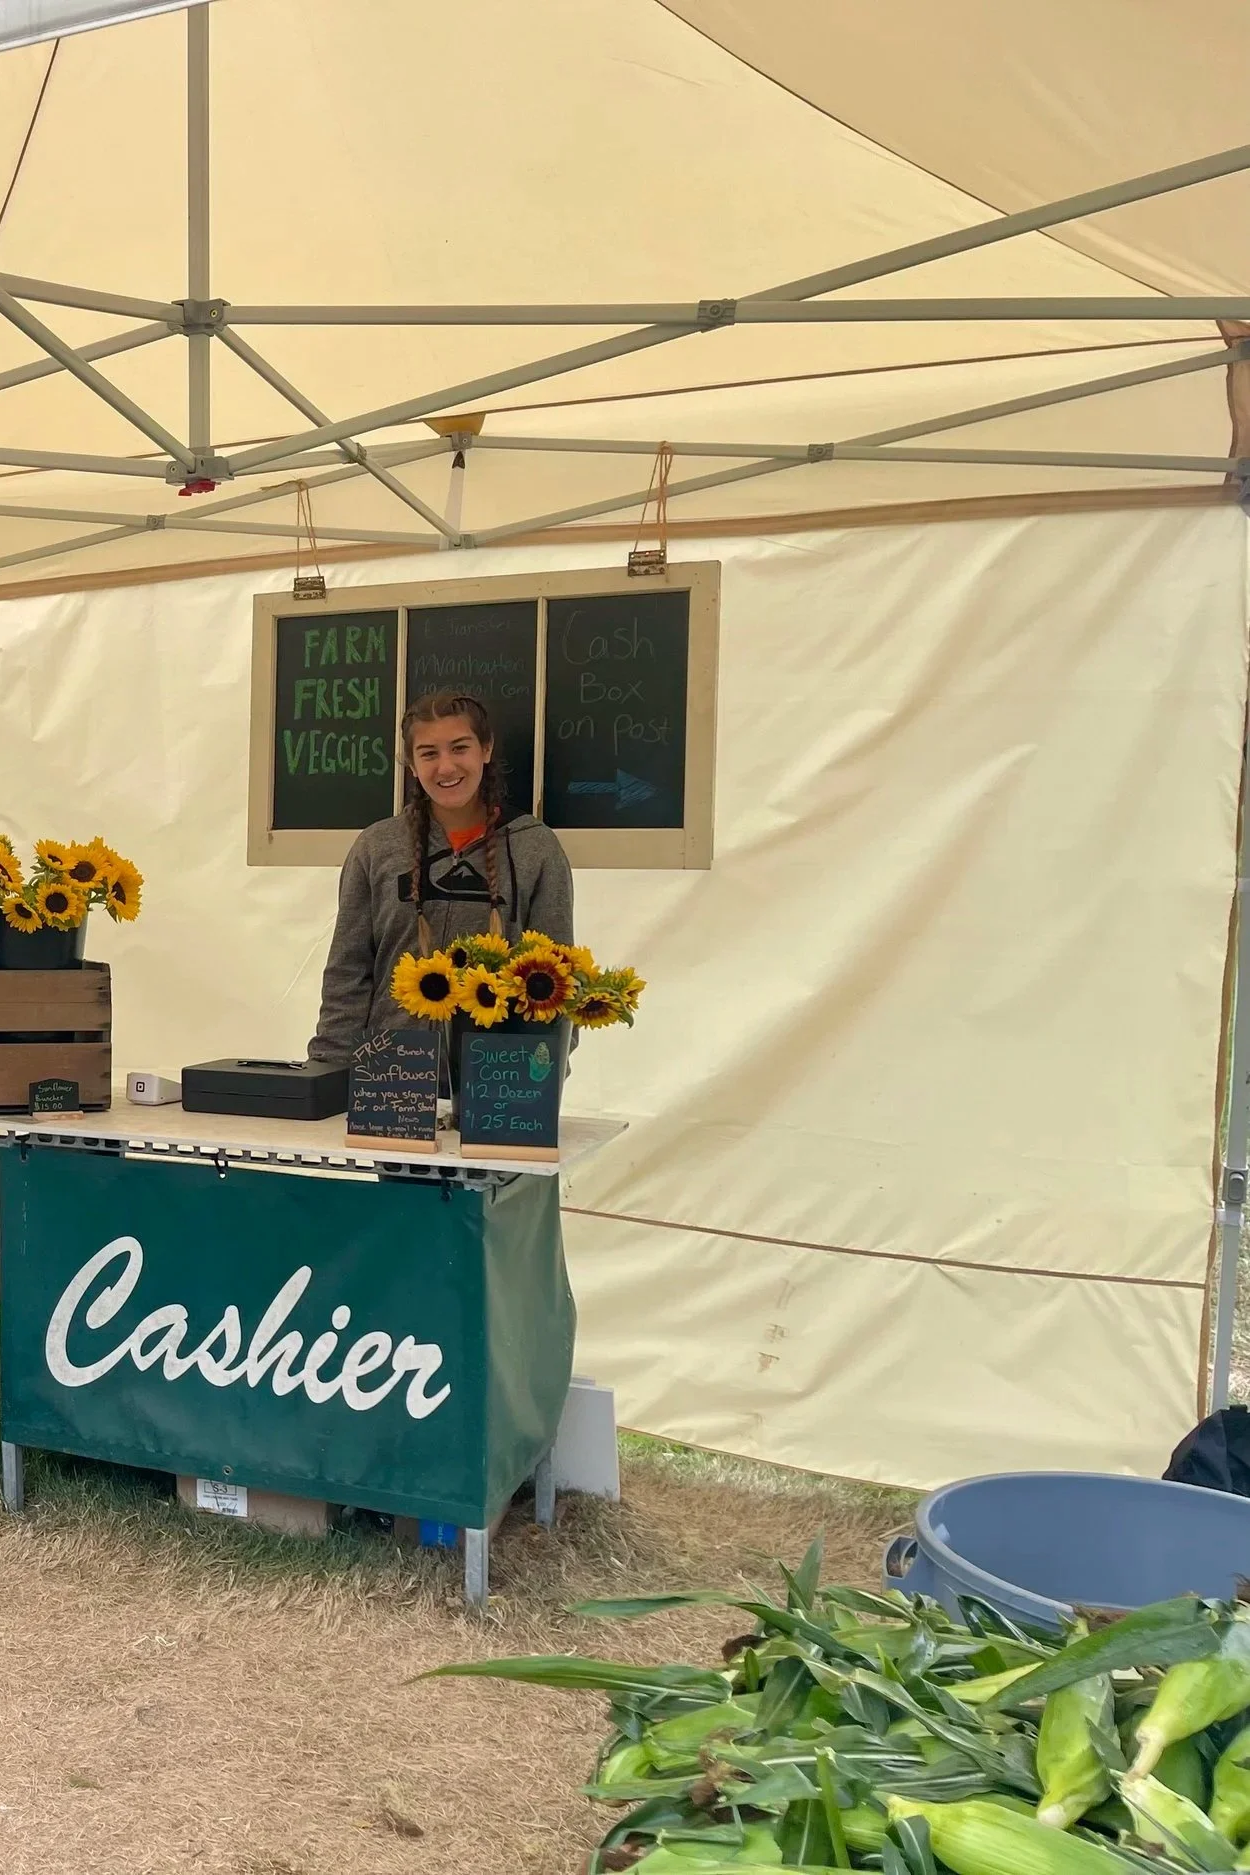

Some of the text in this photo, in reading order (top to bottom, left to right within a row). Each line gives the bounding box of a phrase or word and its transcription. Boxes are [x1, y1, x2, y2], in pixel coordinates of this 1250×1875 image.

[304, 625, 386, 668] FARM
[562, 610, 655, 665] Cash
[294, 677, 379, 720] FRESH
[580, 672, 645, 704] Box
[558, 715, 594, 739] on
[352, 1029, 393, 1063] FREE
[396, 1045, 425, 1057] Bunch
[469, 1038, 529, 1065] Sweet
[354, 1064, 437, 1082] Sunflowers
[479, 1064, 520, 1082] Corn
[380, 1091, 398, 1104] you
[402, 1090, 422, 1104] sign
[424, 1093, 435, 1104] up
[499, 1084, 542, 1099] Dozen
[353, 1100, 367, 1112] for
[391, 1100, 416, 1112] Farm
[493, 1102, 509, 1110] or
[509, 1116, 543, 1131] Each
[46, 1236, 450, 1419] Cashier
